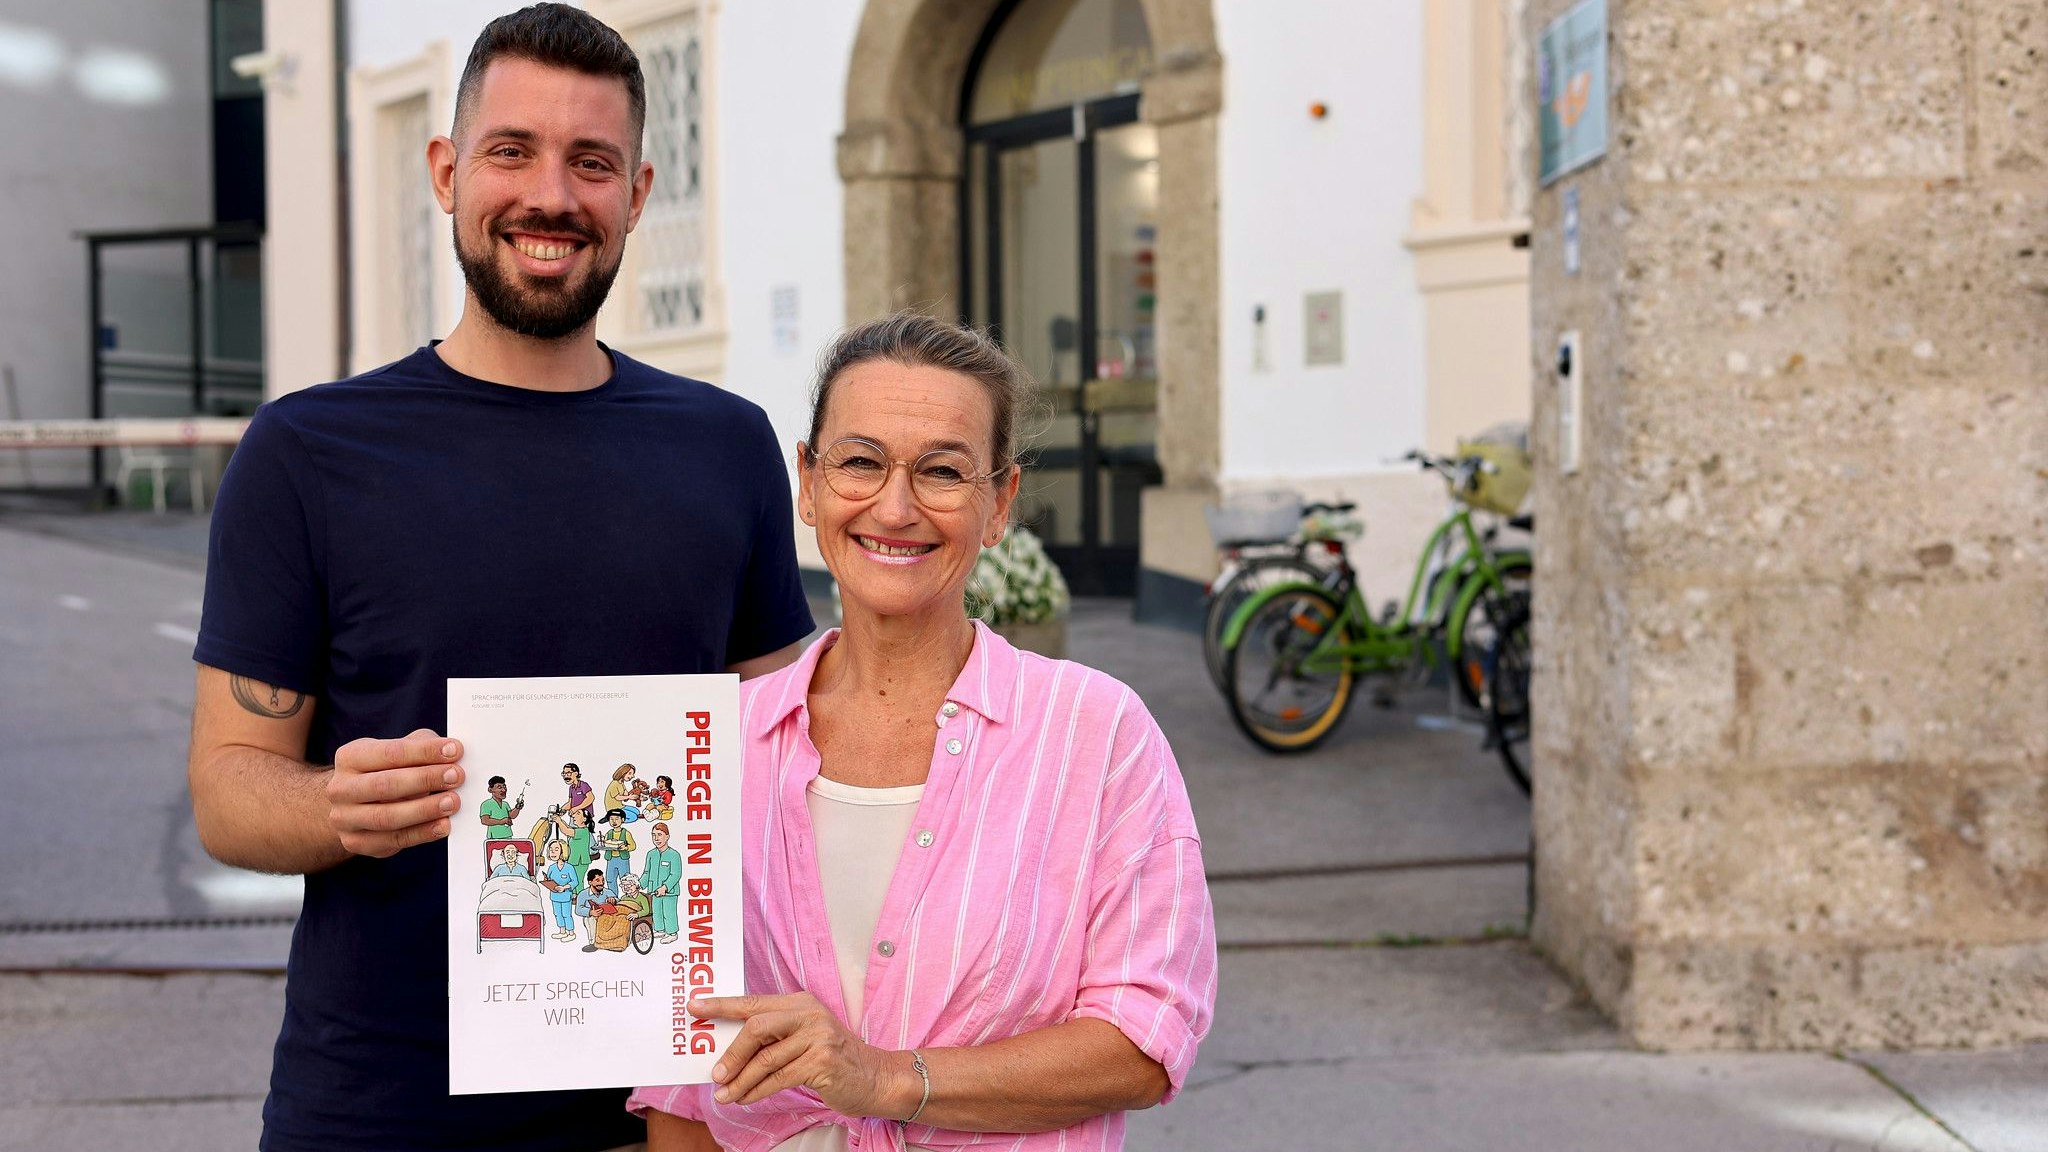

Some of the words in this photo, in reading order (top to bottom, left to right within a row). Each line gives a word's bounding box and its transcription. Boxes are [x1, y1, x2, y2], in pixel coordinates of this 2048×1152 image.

[513, 693, 525, 701] FÜR
[686, 711, 711, 821] PFLEGE
[687, 834, 712, 864] IN
[483, 982, 540, 1003] JETZT
[546, 980, 644, 1001] SPRECHEN
[671, 953, 687, 1056] ÖSTERREICH
[543, 1007, 585, 1026] WIR!
